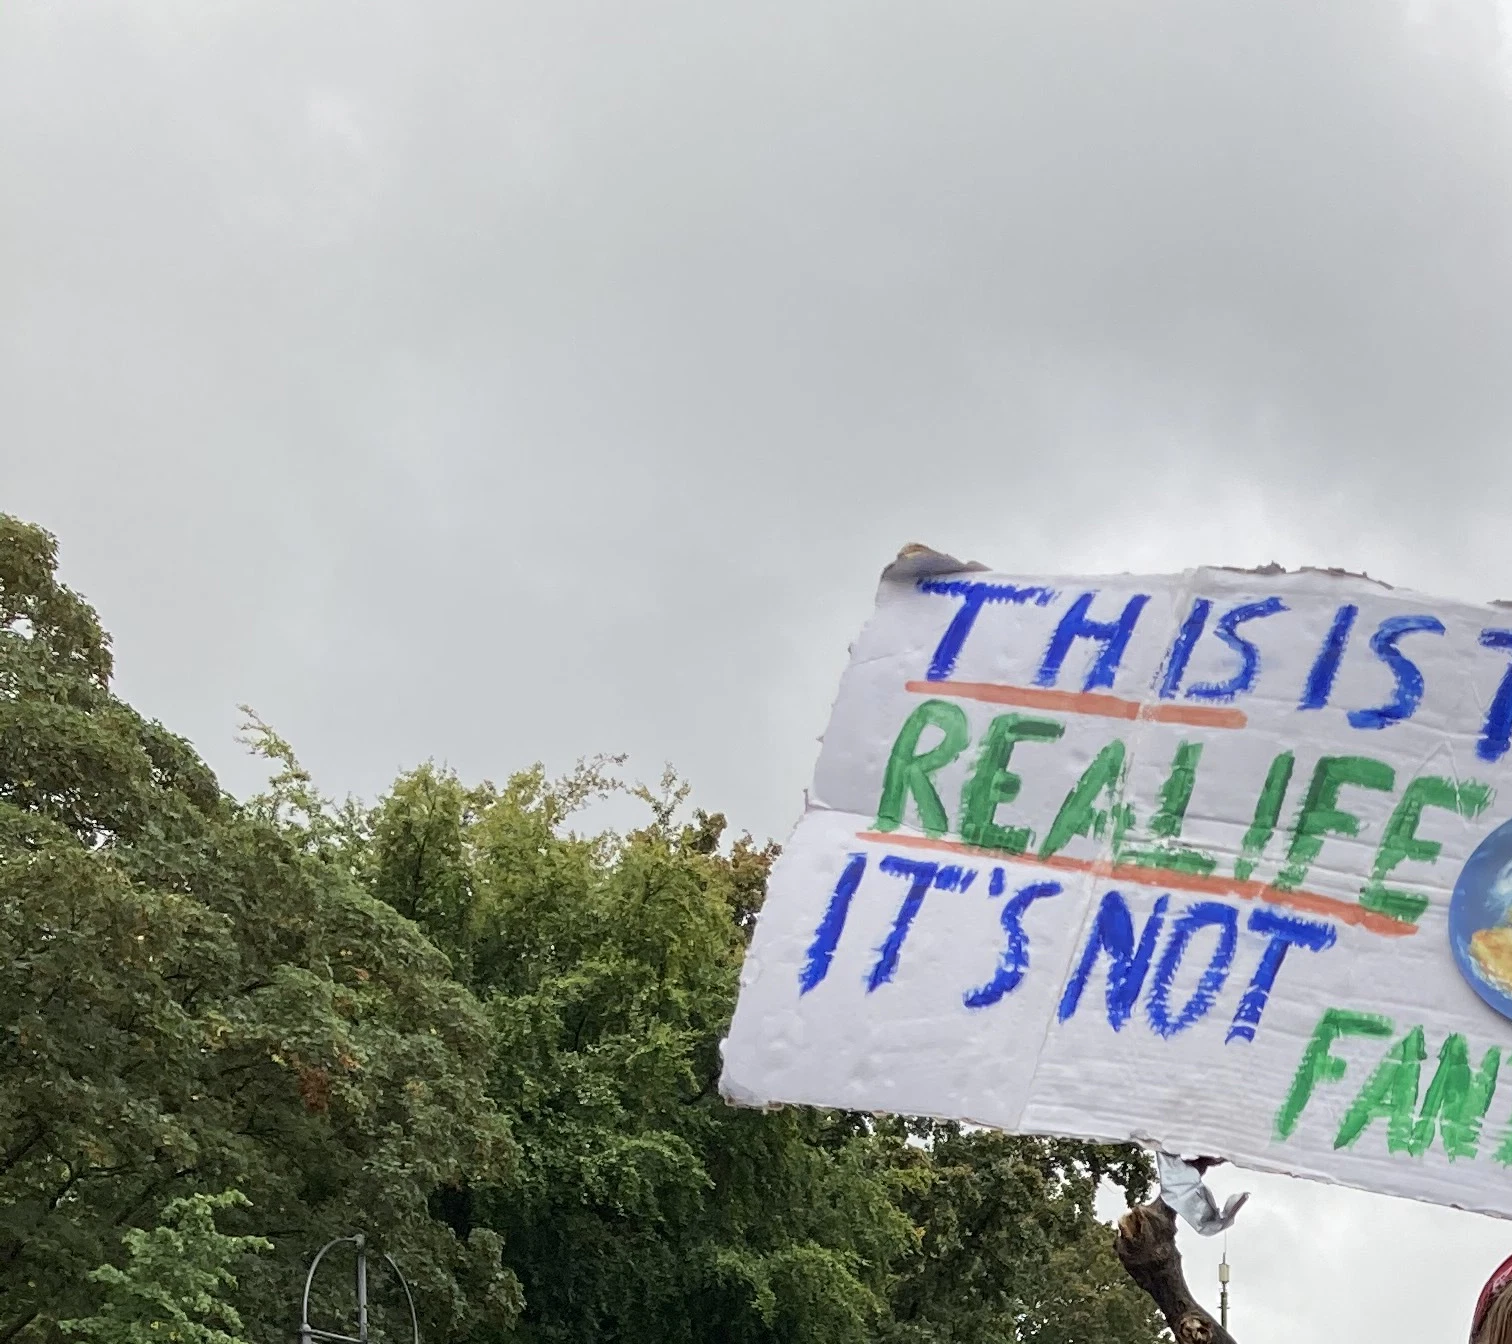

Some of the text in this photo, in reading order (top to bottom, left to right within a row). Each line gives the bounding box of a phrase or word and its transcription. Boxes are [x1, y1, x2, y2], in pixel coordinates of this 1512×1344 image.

[917, 578, 1290, 702] THIS
[1301, 603, 1448, 730] IS
[872, 698, 1498, 923] REALIFE
[800, 851, 1339, 1045] IT'S NOT
